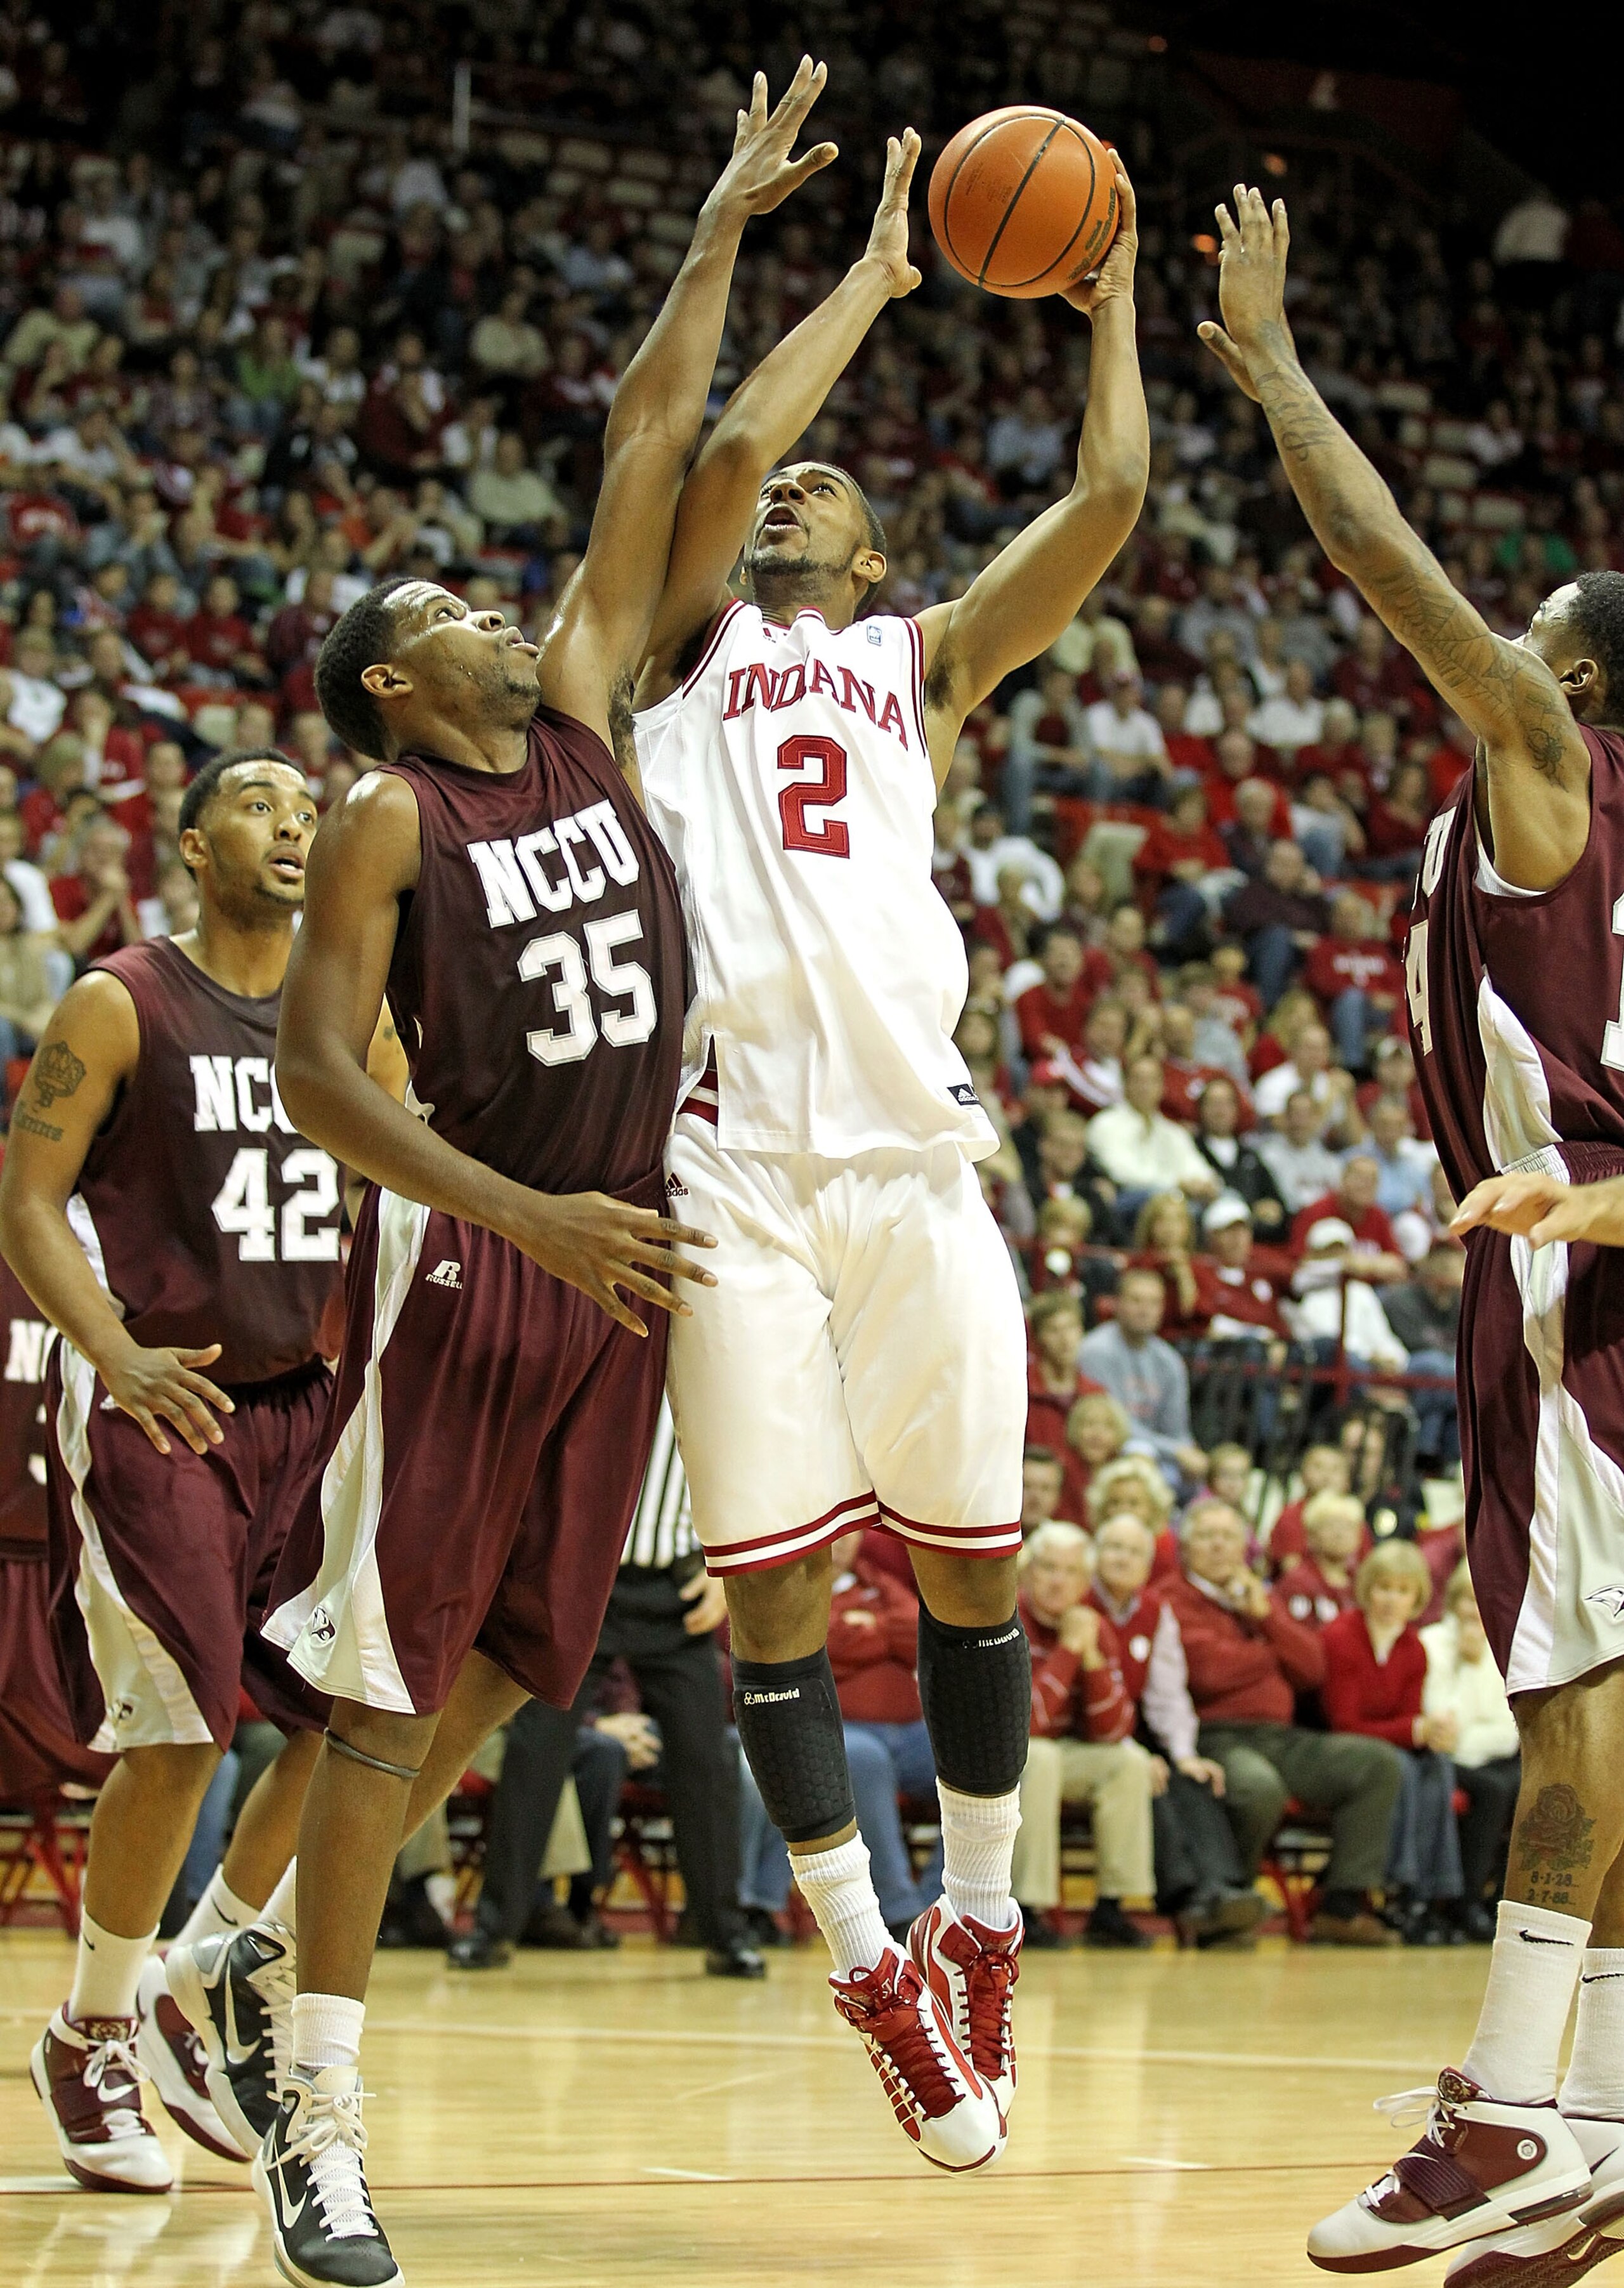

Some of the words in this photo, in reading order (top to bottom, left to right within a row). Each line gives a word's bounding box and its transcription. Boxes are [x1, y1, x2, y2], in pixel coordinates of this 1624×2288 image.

[777, 735, 849, 859] 2
[467, 799, 639, 928] NCCU
[517, 909, 657, 1067] 35
[211, 1147, 339, 1262] 42
[425, 1274, 463, 1290] RUSSELL
[754, 1688, 800, 1704] McDavid
